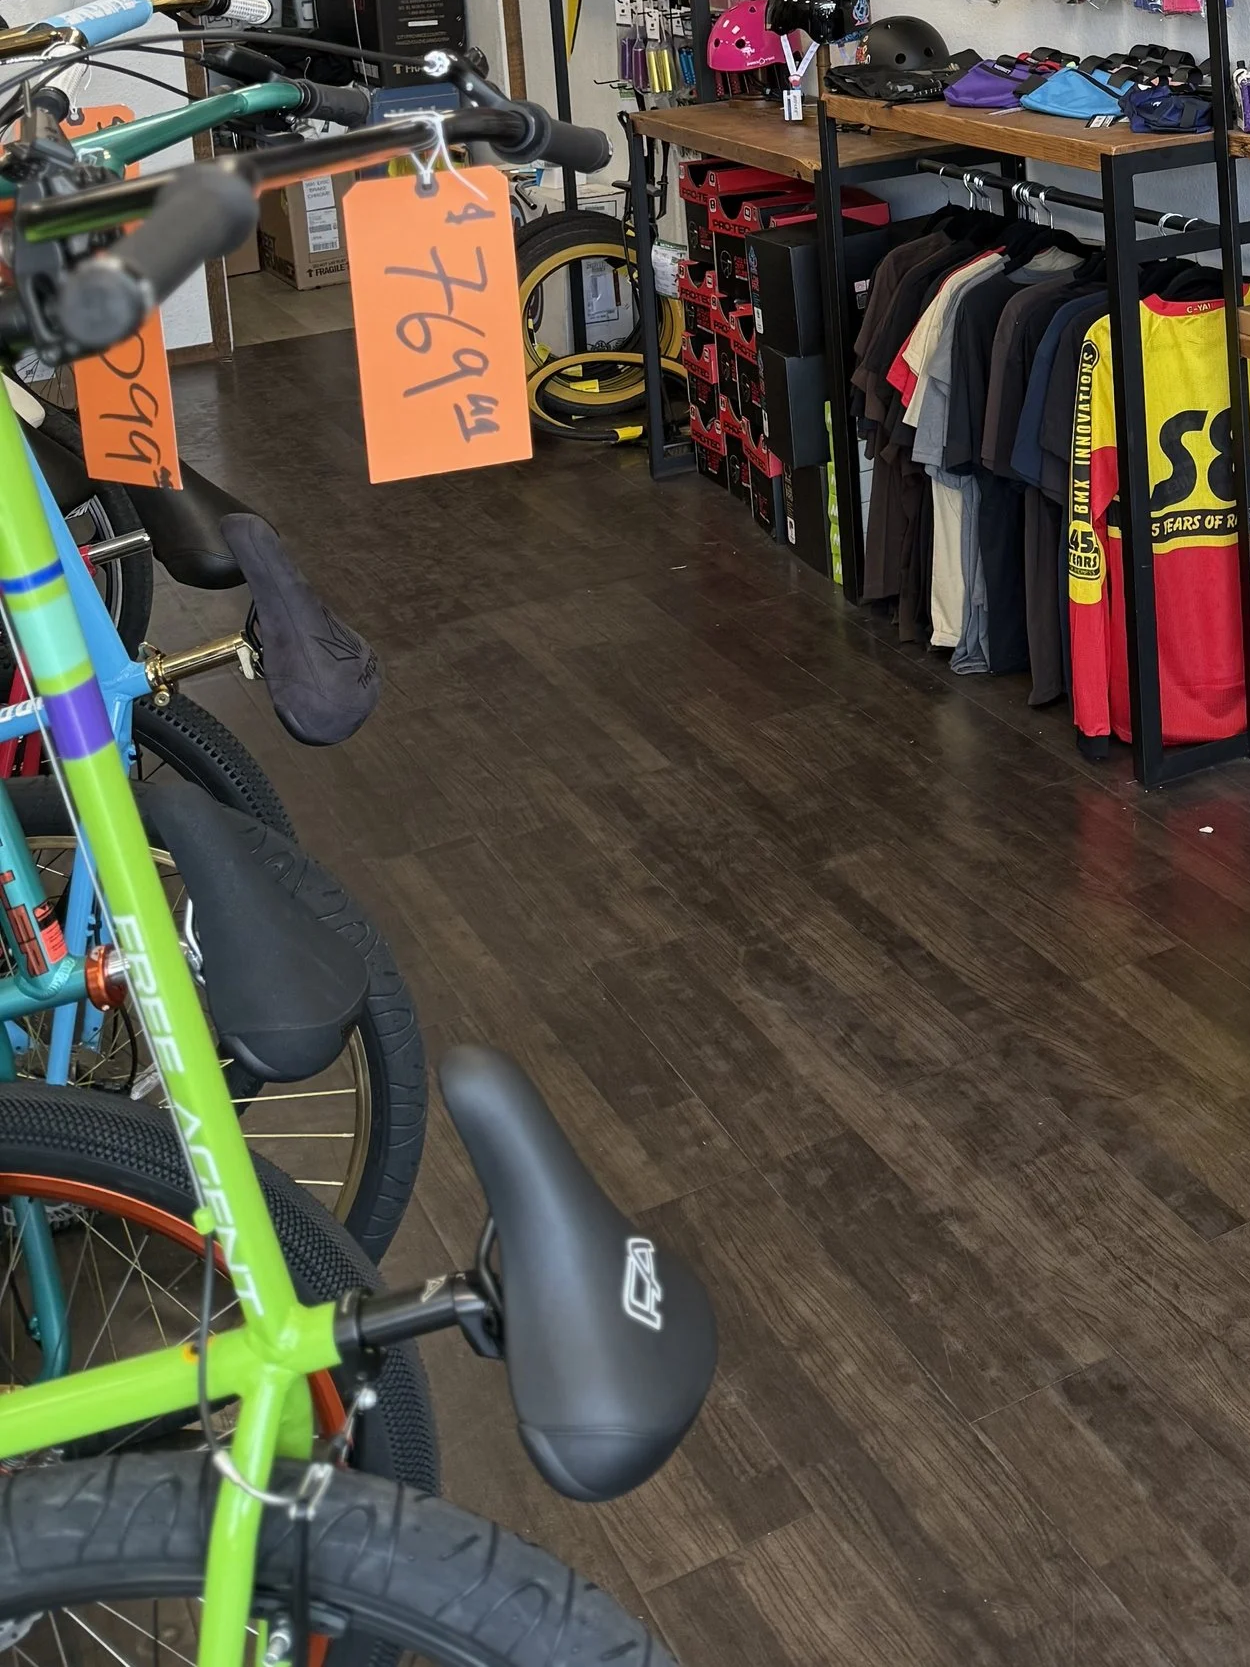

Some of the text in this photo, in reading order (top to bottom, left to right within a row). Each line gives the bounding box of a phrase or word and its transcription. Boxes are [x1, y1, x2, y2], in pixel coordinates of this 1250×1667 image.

[712, 219, 751, 235] PRO-TEC
[315, 264, 346, 276] FRAGILE
[1073, 340, 1096, 516] BMX INNOVATIONS
[1162, 517, 1201, 536] YEARS
[1204, 515, 1222, 532] OF
[1068, 528, 1096, 555] 45
[112, 914, 186, 1074] FREE
[170, 1100, 266, 1320] AGENT
